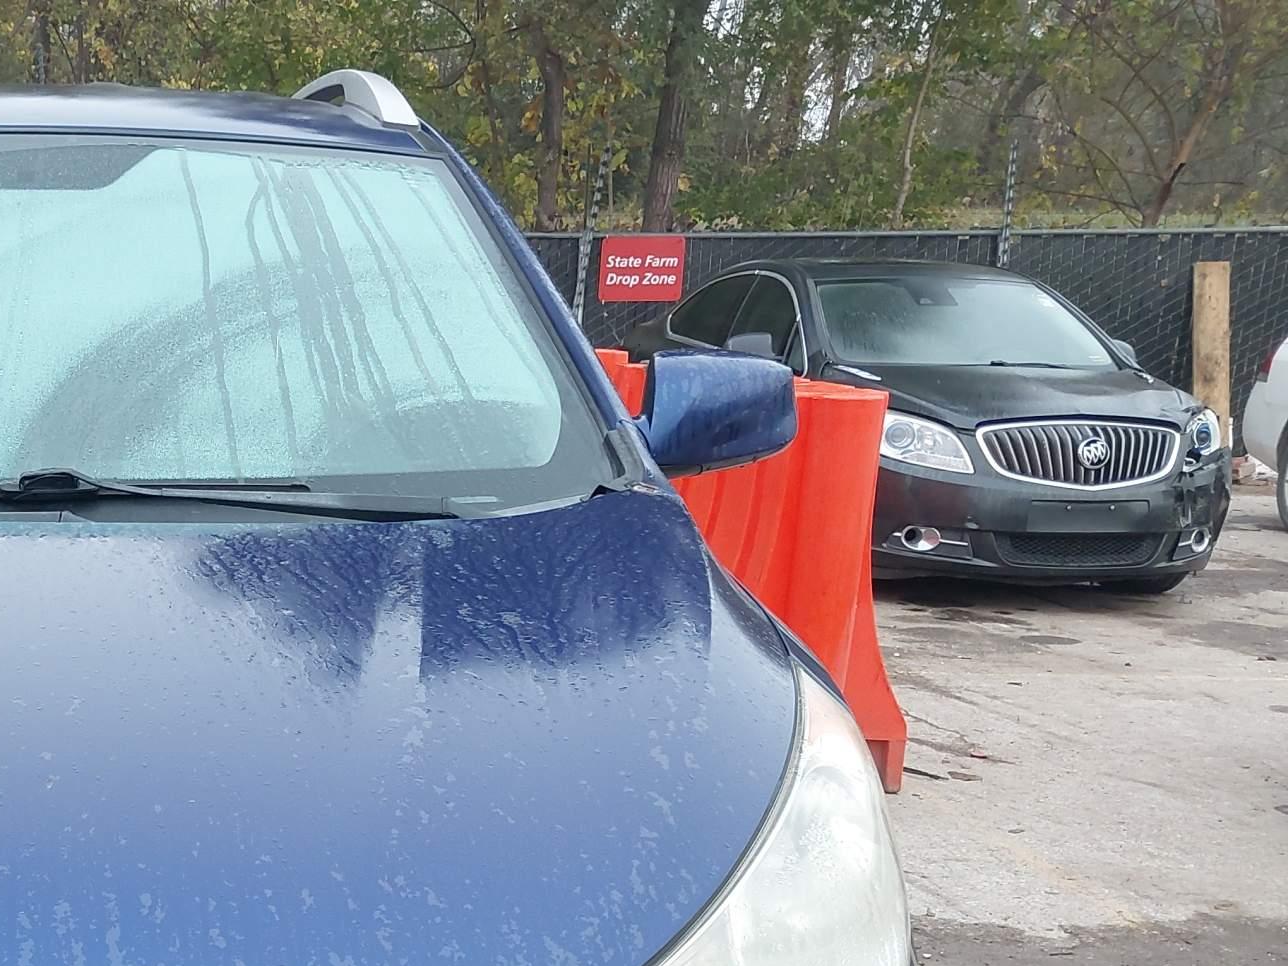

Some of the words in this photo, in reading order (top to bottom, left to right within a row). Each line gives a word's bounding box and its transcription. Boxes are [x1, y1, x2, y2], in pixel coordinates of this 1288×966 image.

[605, 255, 642, 268] State
[644, 255, 678, 268] Farm
[605, 273, 640, 288] Drop
[641, 273, 677, 286] Zone
